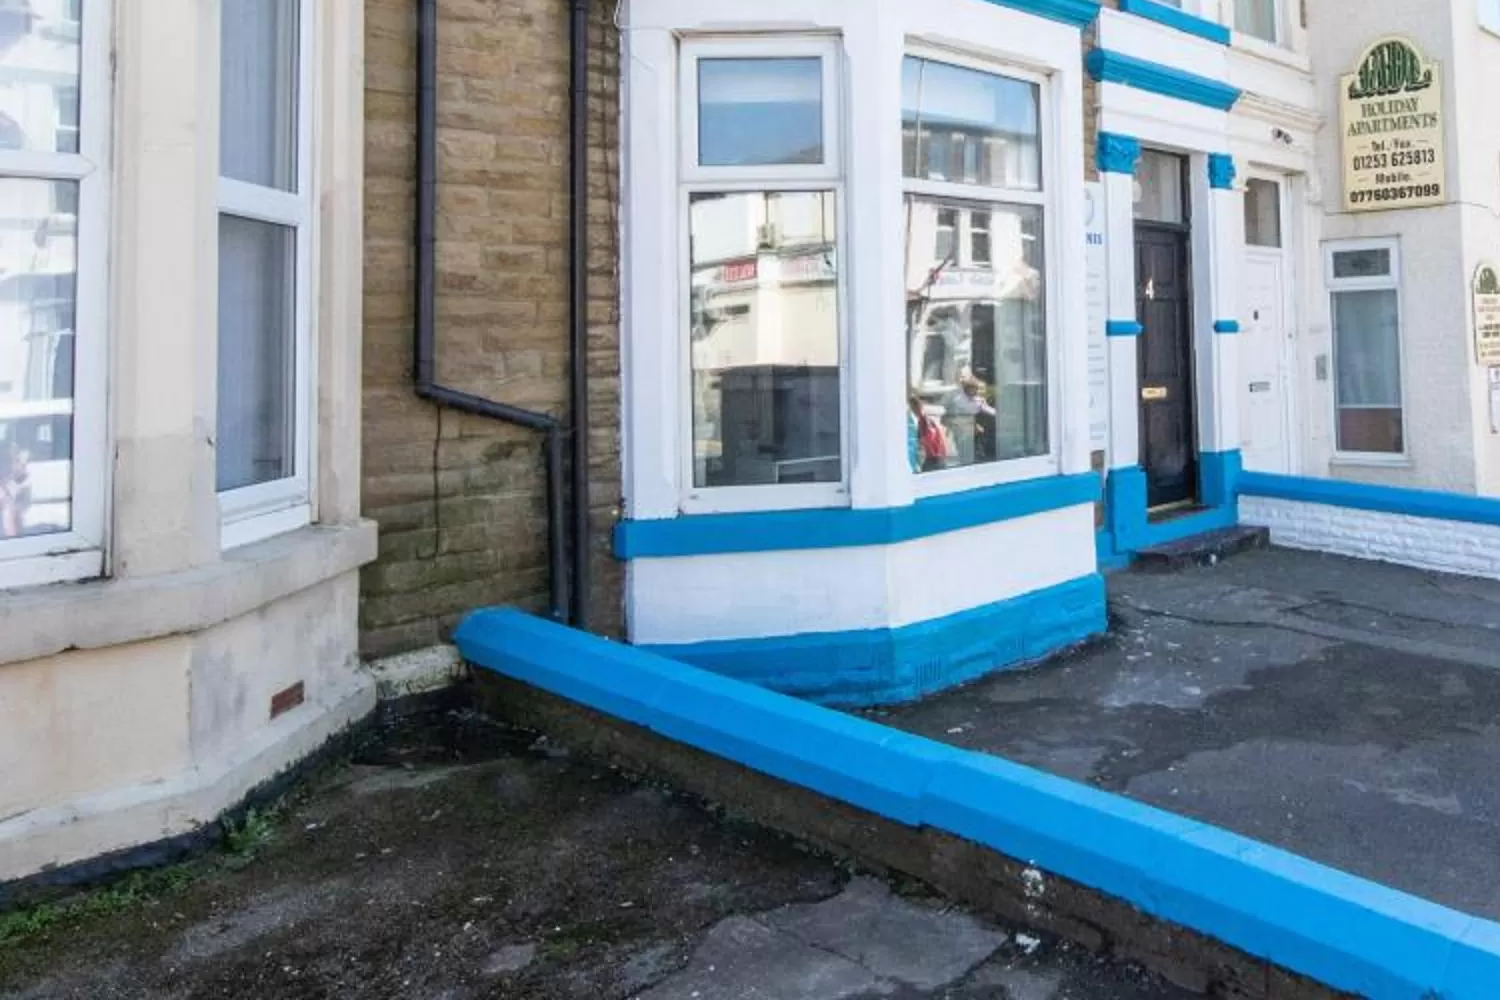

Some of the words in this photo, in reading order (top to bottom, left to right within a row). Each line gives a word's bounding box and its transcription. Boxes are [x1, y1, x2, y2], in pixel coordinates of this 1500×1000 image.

[1361, 98, 1419, 117] HOLIDAY
[1348, 113, 1437, 136] APARTMENTS
[1353, 153, 1387, 170] 01253
[1391, 149, 1435, 167] 625813
